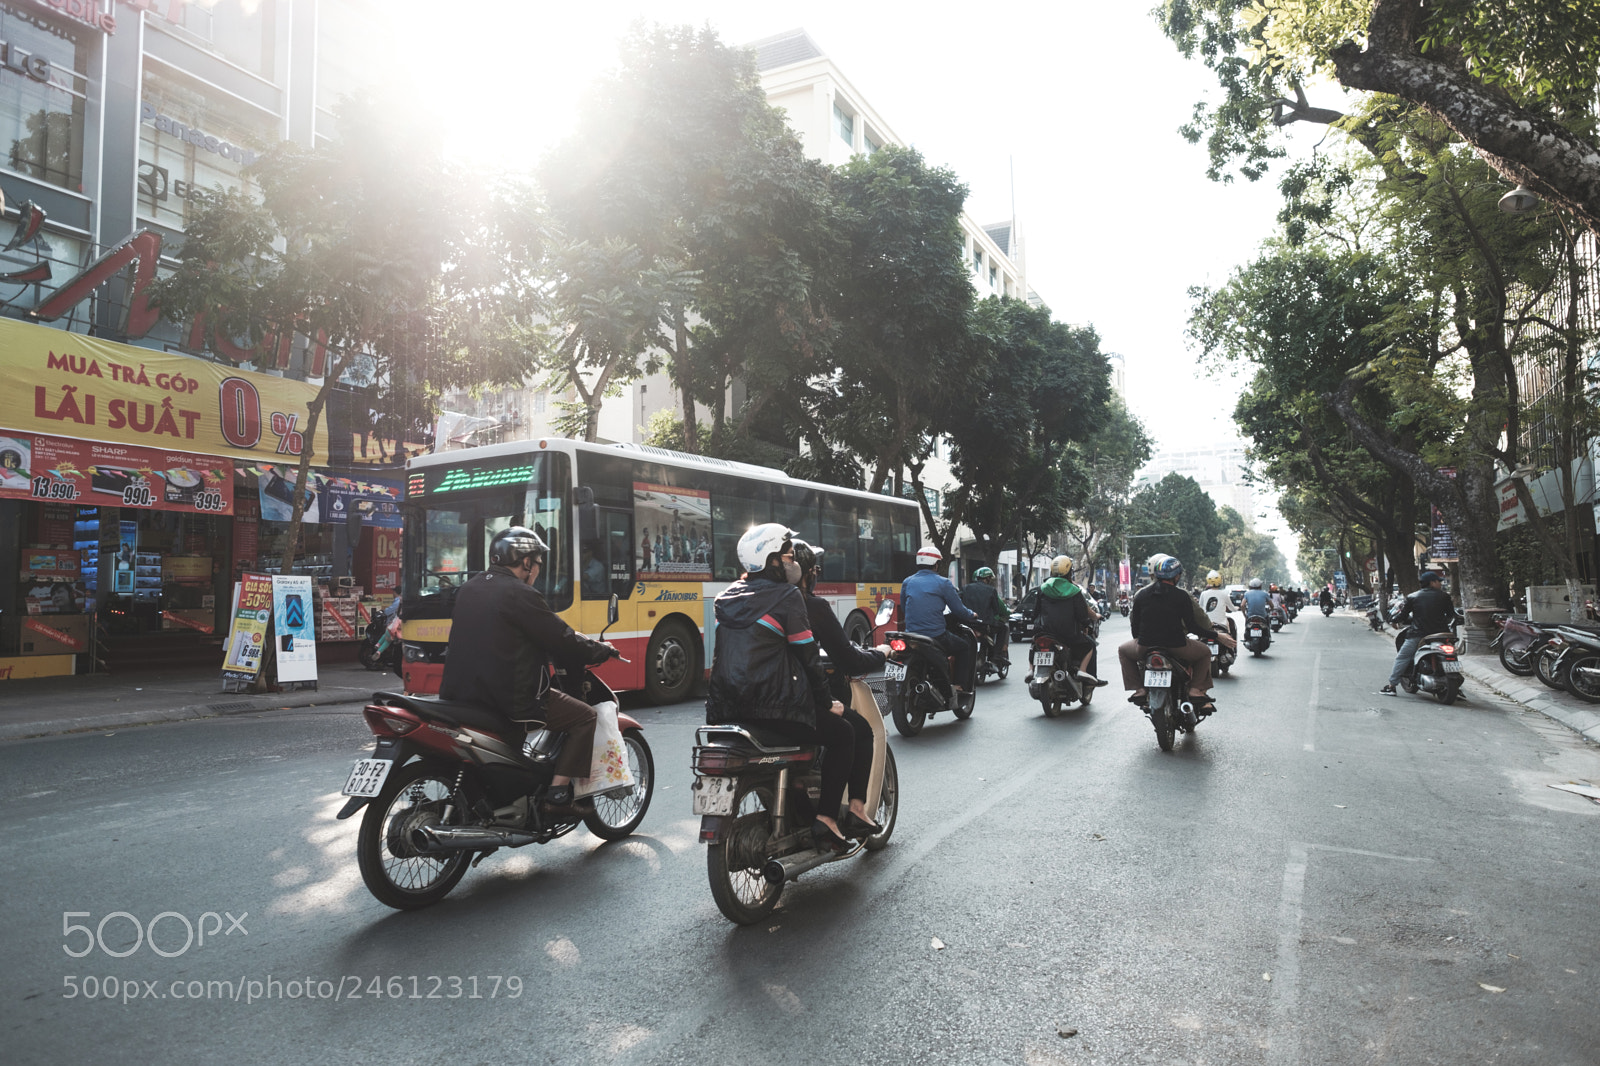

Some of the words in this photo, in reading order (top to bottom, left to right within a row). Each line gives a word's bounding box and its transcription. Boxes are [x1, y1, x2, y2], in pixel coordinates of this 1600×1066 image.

[7, 40, 49, 82] LG
[47, 350, 104, 378] MUA
[107, 363, 151, 387] TRẢ
[155, 372, 199, 395] GÓP
[34, 384, 96, 426] LÃI
[107, 396, 201, 440] SUẤT
[92, 446, 127, 455] SHARP
[166, 455, 193, 464] goldsun
[241, 593, 271, 609] -50%
[654, 589, 699, 600] HANOIBUS
